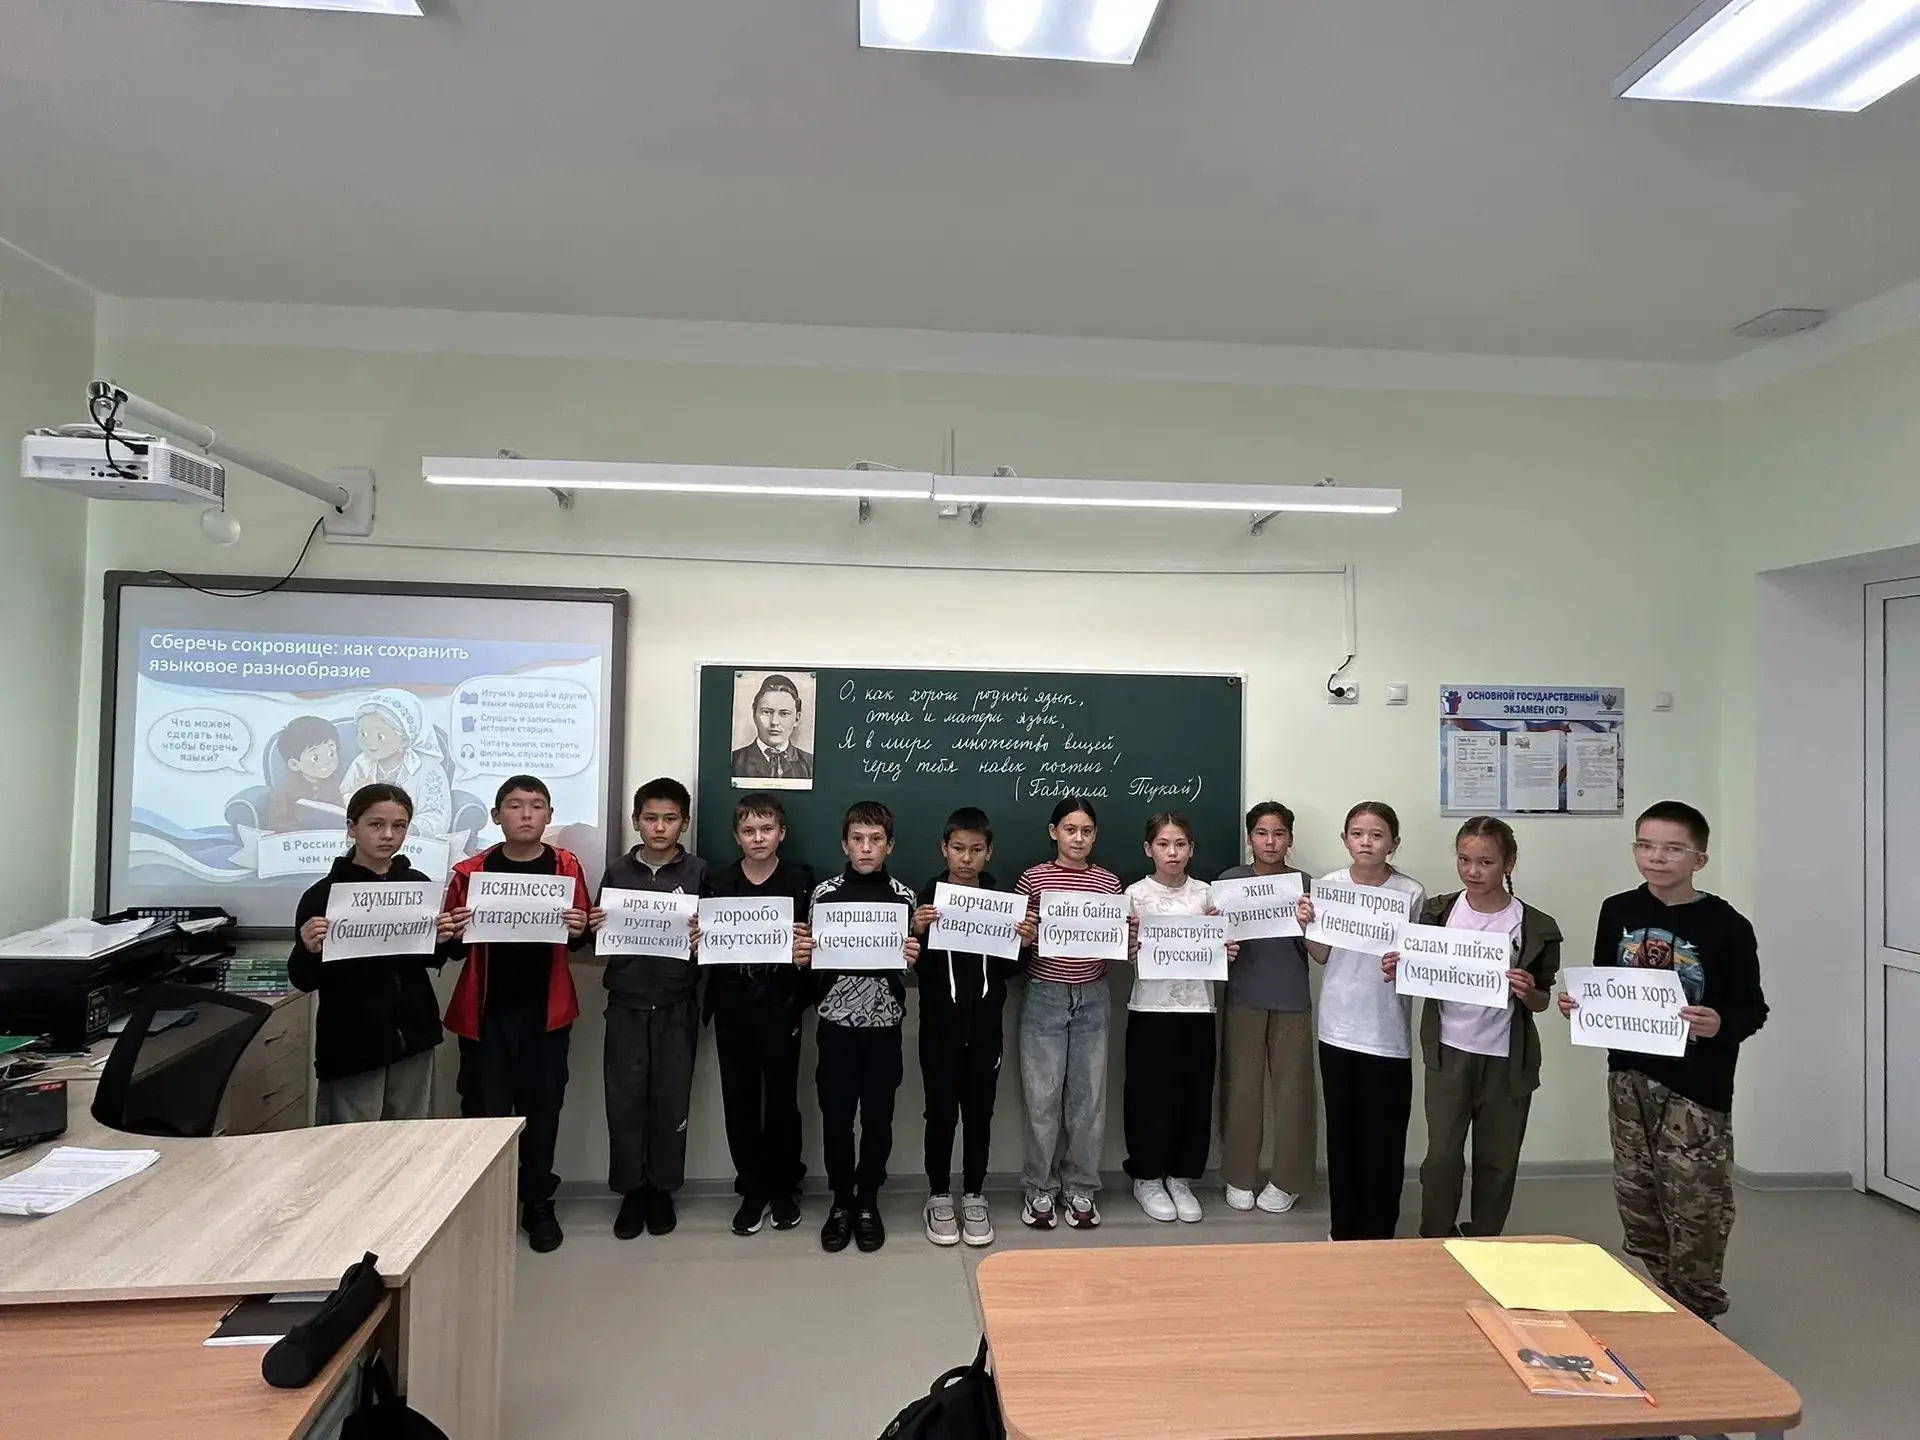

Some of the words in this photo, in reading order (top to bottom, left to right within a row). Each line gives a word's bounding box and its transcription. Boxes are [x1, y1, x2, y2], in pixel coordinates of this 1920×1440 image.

[150, 634, 227, 652] Сберечь
[232, 640, 338, 656] сокровище:
[344, 643, 373, 656] как
[378, 645, 469, 661] сохранить
[149, 660, 238, 674] языковое
[242, 661, 371, 679] разнообразие
[839, 679, 856, 702] О,
[864, 688, 896, 701] как
[909, 689, 960, 711] хорош
[972, 687, 1030, 712] родной
[1035, 691, 1084, 713] язык,
[1467, 689, 1515, 701] ОСНОВНОЙ
[1516, 690, 1600, 702] ГОСУДАРСТВЕННЫЙ
[1503, 704, 1545, 715] ЭКЗАМЕН
[1546, 705, 1568, 716] (ОГЭ)
[171, 718, 191, 728] Что
[194, 720, 231, 729] можем
[866, 709, 914, 726] отца
[924, 713, 936, 723] и
[943, 711, 1004, 735] матери
[1016, 712, 1065, 732] язык,
[166, 731, 213, 740] сделать
[838, 726, 856, 750] Я
[865, 729, 875, 750] в
[880, 736, 933, 763] мире
[952, 734, 1049, 752] множество
[1063, 732, 1115, 755] вещей
[162, 741, 196, 750] чтобы
[199, 742, 239, 753] беречь
[179, 753, 220, 762] языки?
[863, 757, 902, 783] через
[916, 757, 959, 774] тебя
[979, 756, 1027, 774] навек
[1128, 775, 1204, 804] Тукай)
[283, 841, 292, 852] В
[294, 840, 337, 850] России
[298, 855, 320, 864] чем
[480, 880, 566, 898] исянмесез
[1242, 883, 1276, 898] экии
[1317, 885, 1356, 906] ньяни
[1359, 892, 1405, 915] торова
[351, 889, 424, 913] хаумыгыз
[622, 898, 649, 913] ыра
[653, 900, 678, 914] кун
[948, 892, 1015, 915] ворчами
[1047, 901, 1079, 918] сайн
[1082, 901, 1122, 919] байна
[471, 904, 565, 930] (татарский)
[624, 916, 672, 932] пултар
[713, 904, 779, 927] дорообо
[825, 909, 898, 928] маршалла
[330, 914, 434, 945] (башкирский)
[935, 913, 1018, 943] (аварский)
[1043, 925, 1124, 947] (бурятский)
[1143, 923, 1224, 943] здравствуйте
[1321, 909, 1395, 946] (ненецкий)
[602, 931, 688, 951] (чувашский)
[704, 928, 789, 951] (якутский)
[817, 930, 905, 952] (чеченский)
[1404, 936, 1449, 956] салам
[1452, 940, 1504, 962] лийже
[1153, 945, 1213, 966] (русский)
[1404, 959, 1502, 994] (марийский)
[1582, 981, 1601, 999] да
[1606, 977, 1637, 1001] бон
[1641, 984, 1677, 1009] хорз
[1578, 1005, 1685, 1042] (осетинский)
